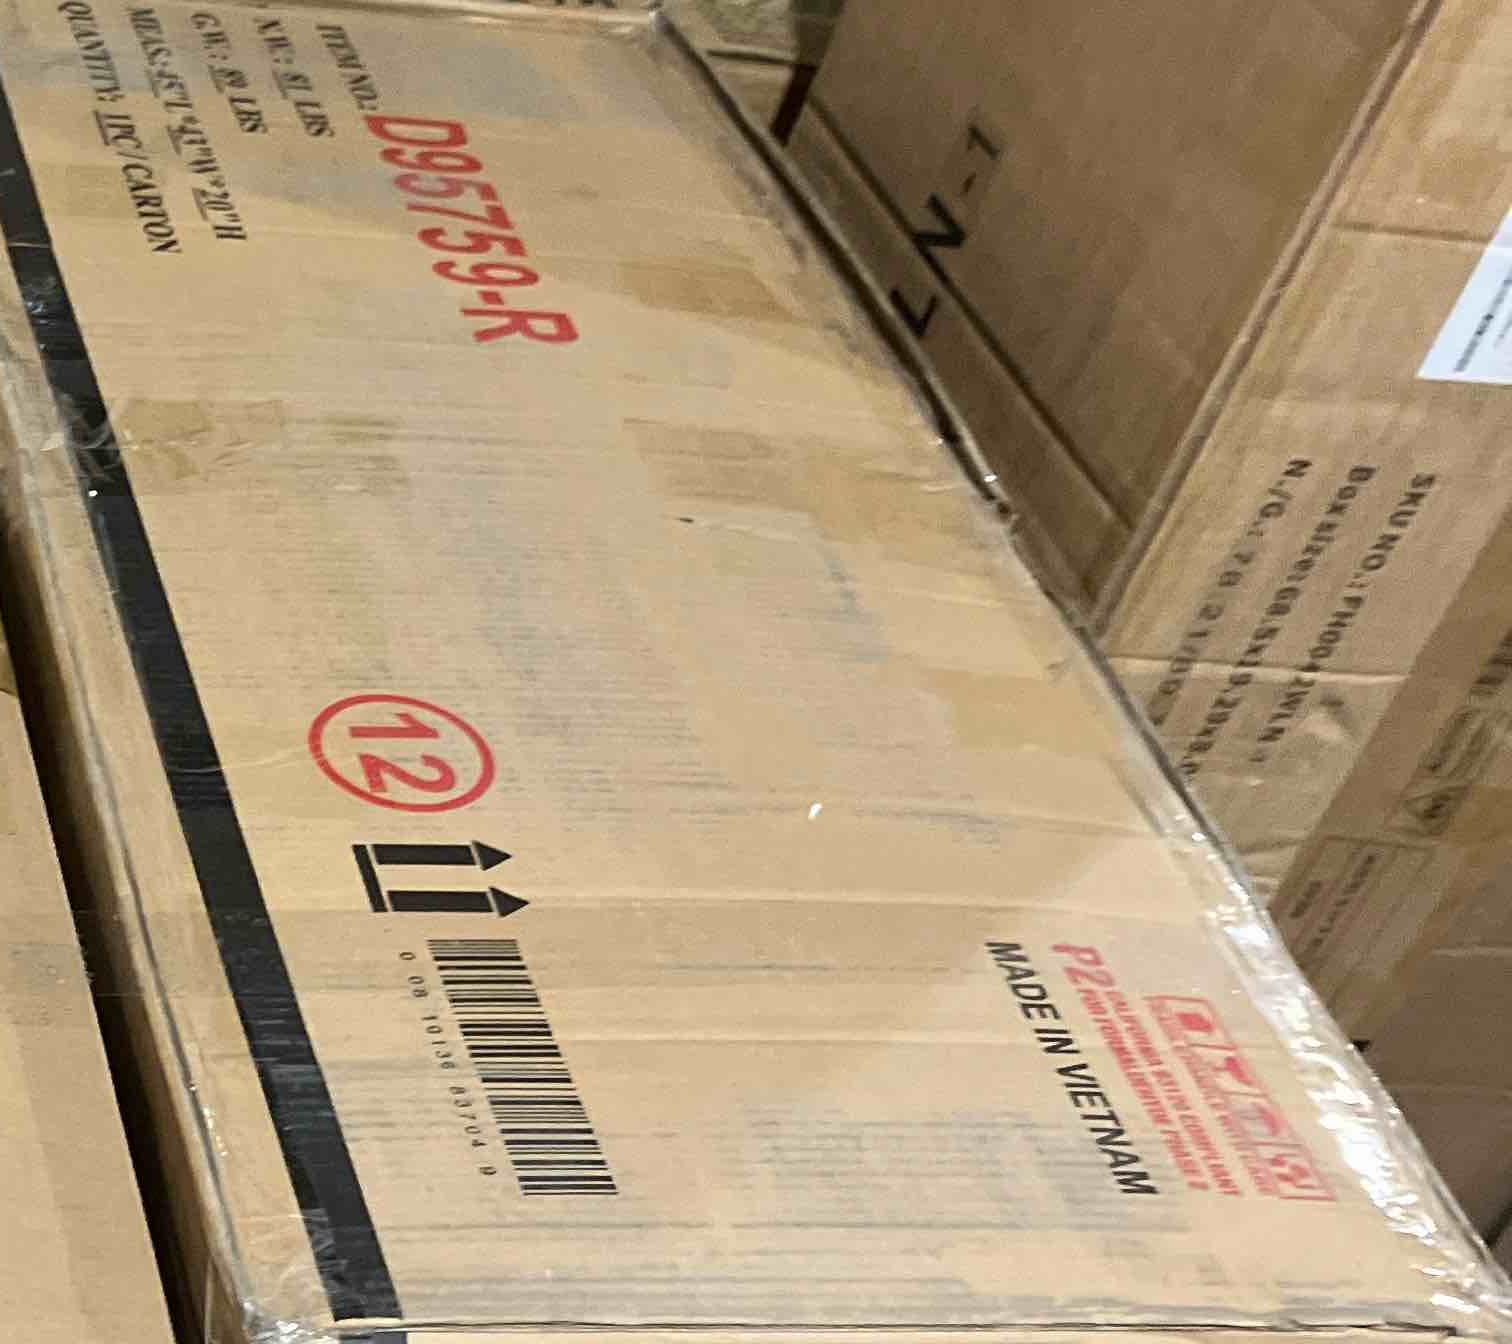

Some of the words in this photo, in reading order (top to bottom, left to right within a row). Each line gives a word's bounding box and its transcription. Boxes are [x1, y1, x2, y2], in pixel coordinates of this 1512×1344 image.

[57, 0, 126, 103] QUANTITY:
[228, 96, 269, 135] LBS
[293, 100, 336, 138] LBS
[315, 24, 368, 70] ITEM
[362, 115, 581, 344] D95759-R
[1324, 465, 1379, 516] Box
[1388, 472, 1437, 529] SKU
[348, 711, 457, 794] 12
[399, 951, 417, 961] 0
[984, 941, 1061, 1021] MADE
[1051, 942, 1116, 989] P2
[407, 975, 430, 999] 08
[1033, 1028, 1082, 1055] IN
[1055, 1063, 1160, 1195] VIETNAM
